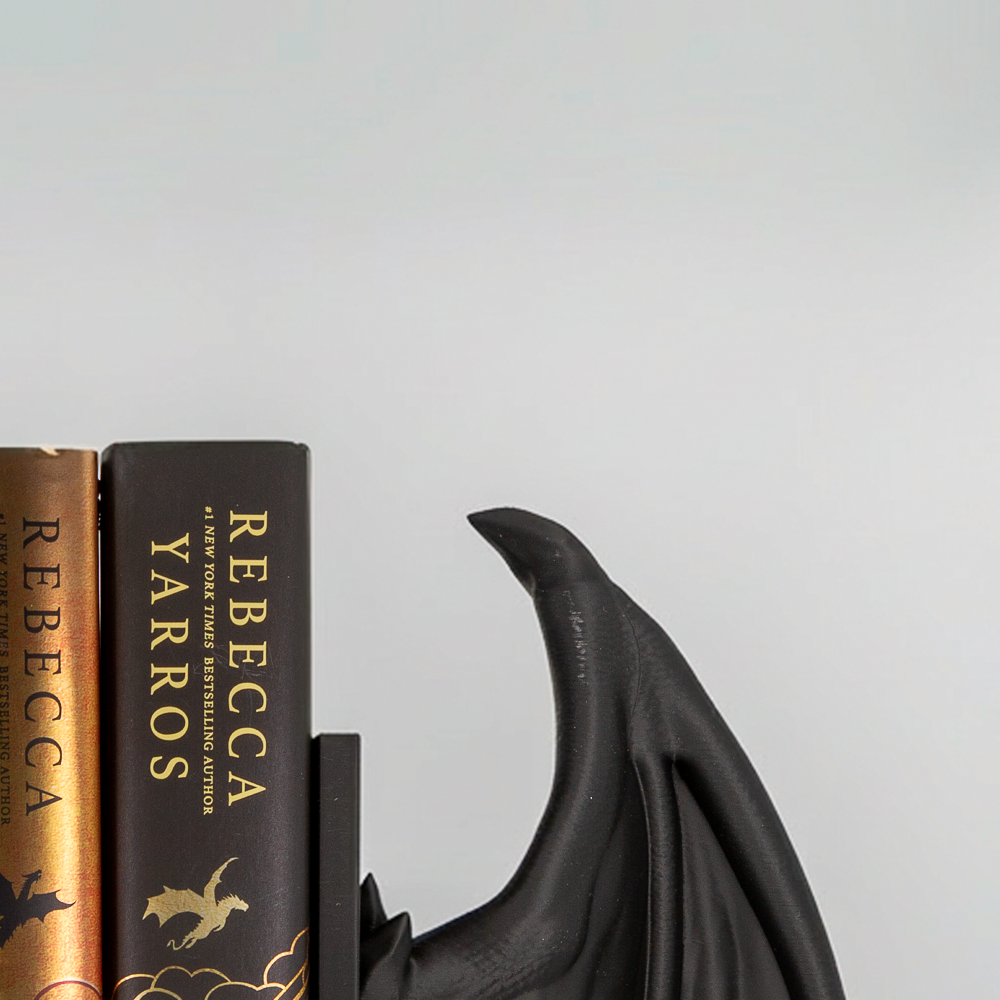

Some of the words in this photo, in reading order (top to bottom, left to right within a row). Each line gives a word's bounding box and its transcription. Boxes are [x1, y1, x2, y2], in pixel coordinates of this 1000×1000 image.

[204, 506, 214, 520] #1
[204, 525, 215, 559] NEW
[204, 563, 214, 600] YORK
[150, 532, 189, 780] YARROS
[204, 604, 214, 649] TIMES
[22, 516, 63, 816] REBECCA
[228, 510, 268, 807] REBECCA
[0, 665, 10, 761] BESTSELLING
[203, 657, 214, 751] BESTSELLING
[0, 766, 11, 825] AUTHOR
[203, 755, 214, 815] AUTHOR
